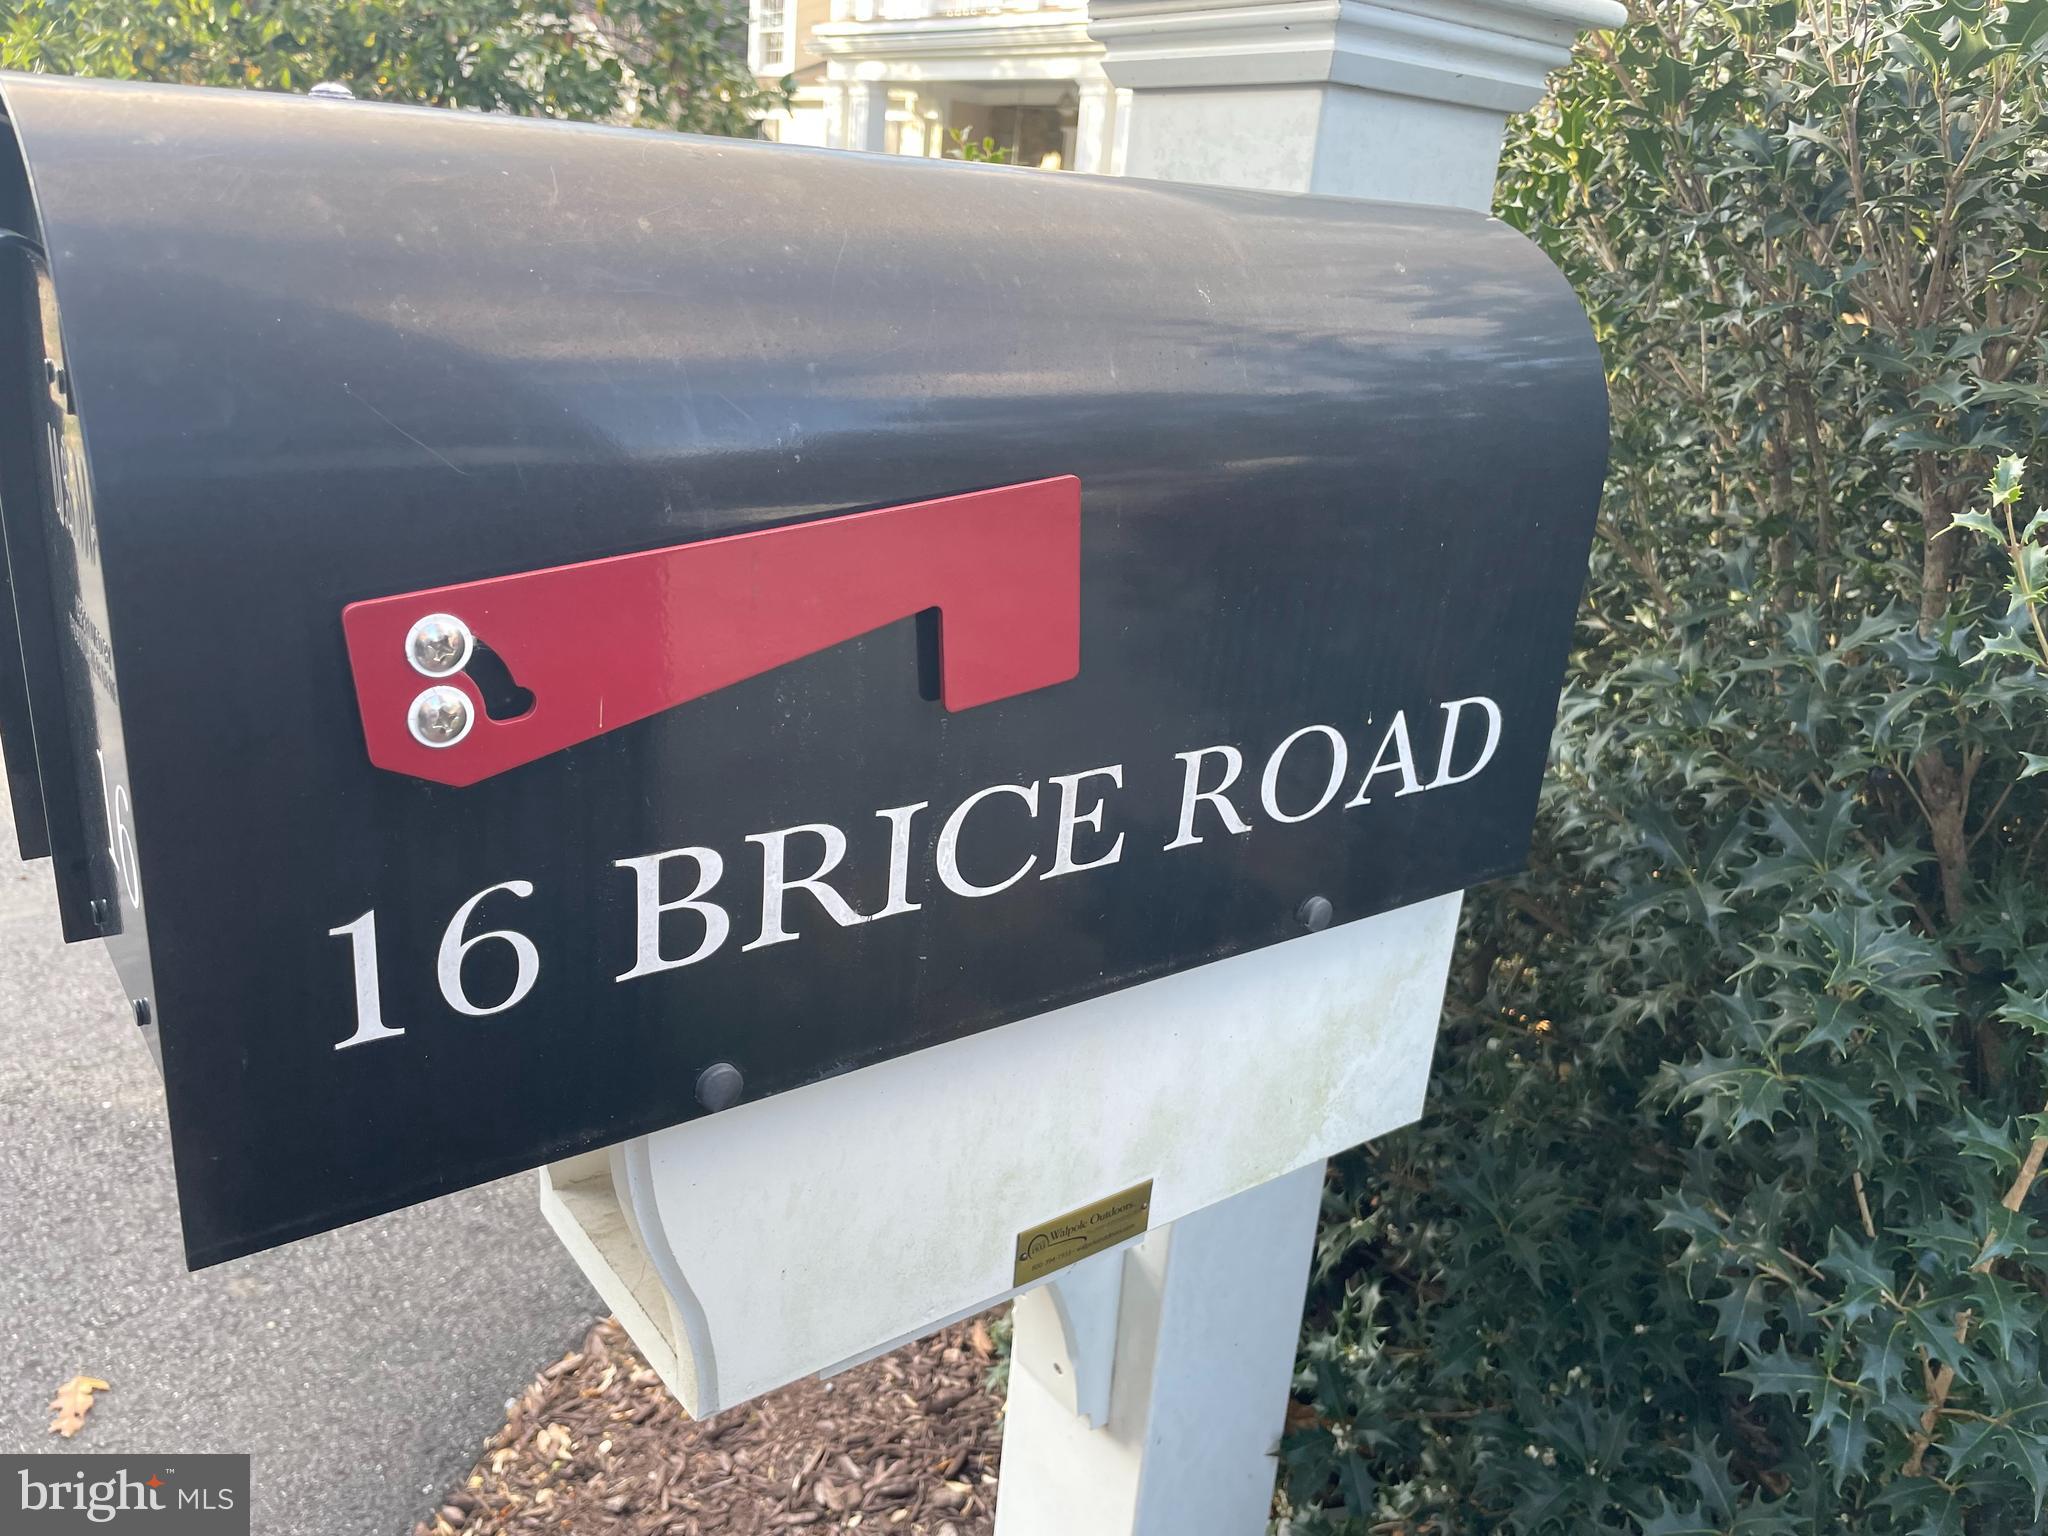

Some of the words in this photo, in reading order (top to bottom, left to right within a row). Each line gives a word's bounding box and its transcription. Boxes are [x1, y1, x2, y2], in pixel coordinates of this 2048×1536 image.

[96, 748, 140, 910] 16
[328, 880, 540, 1050] 16
[614, 763, 1125, 983] BRICE
[1163, 696, 1502, 851] ROAD
[1049, 1220, 1087, 1241] Walpole
[1089, 1202, 1134, 1225] Outdoors
